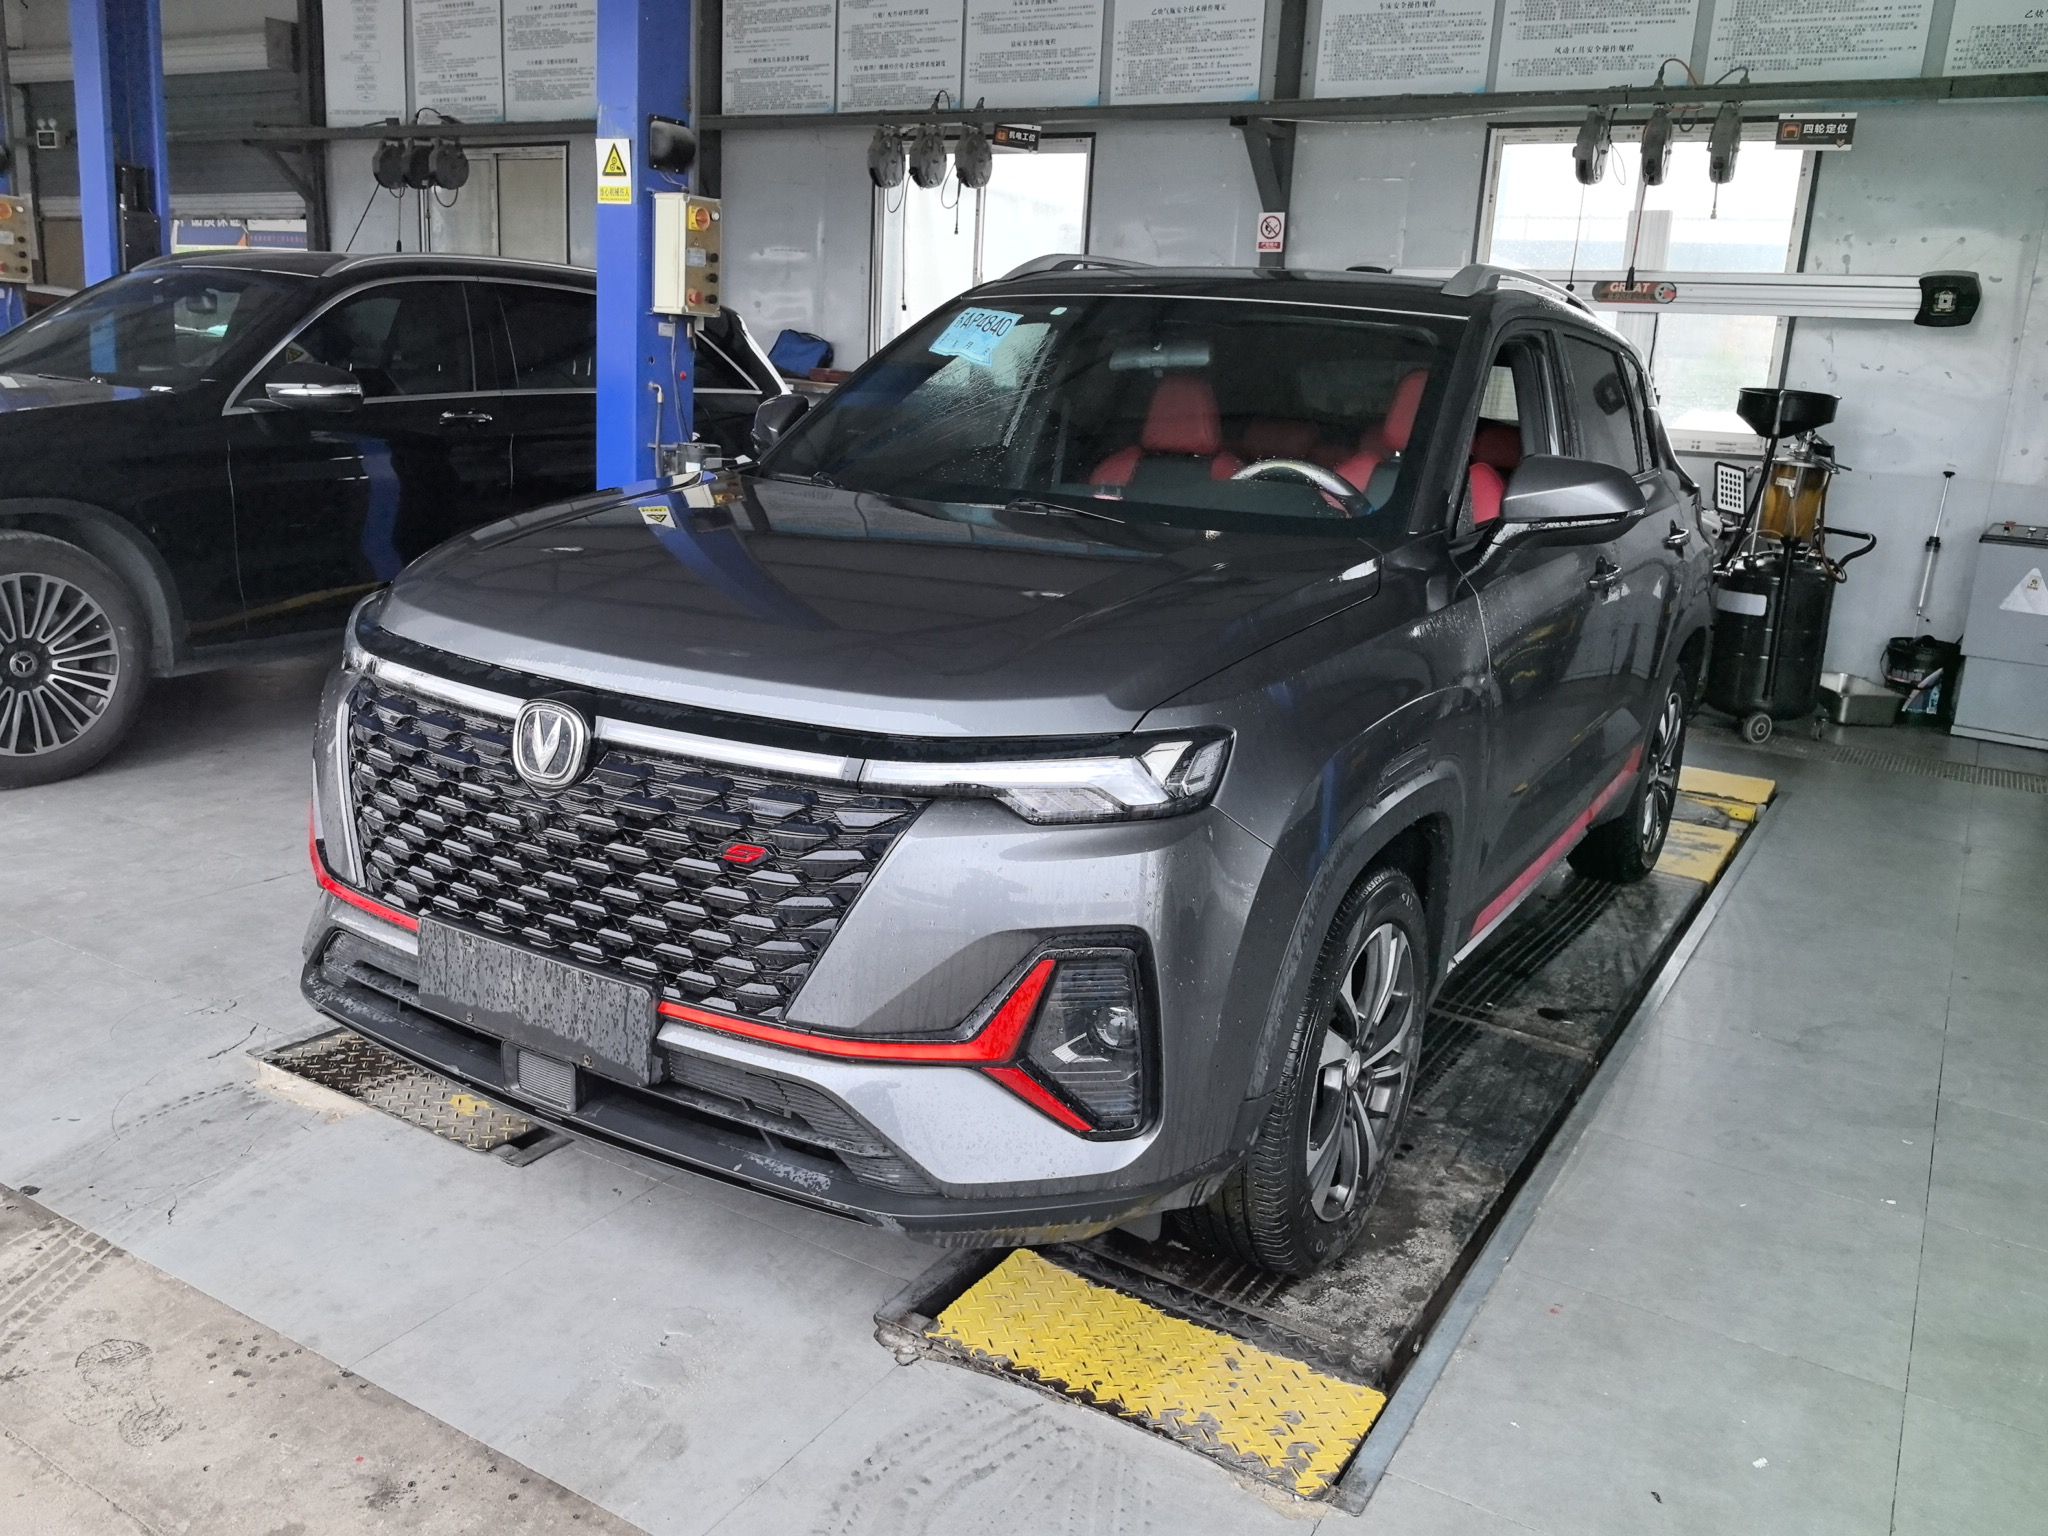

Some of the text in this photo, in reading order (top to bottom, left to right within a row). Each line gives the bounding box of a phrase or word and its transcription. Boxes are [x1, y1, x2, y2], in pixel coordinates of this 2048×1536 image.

[2024, 9, 2048, 18] 乙炔
[1803, 123, 1848, 134] 四轮定位
[1009, 131, 1036, 142] 机电工位
[1610, 282, 1650, 293] GRAT
